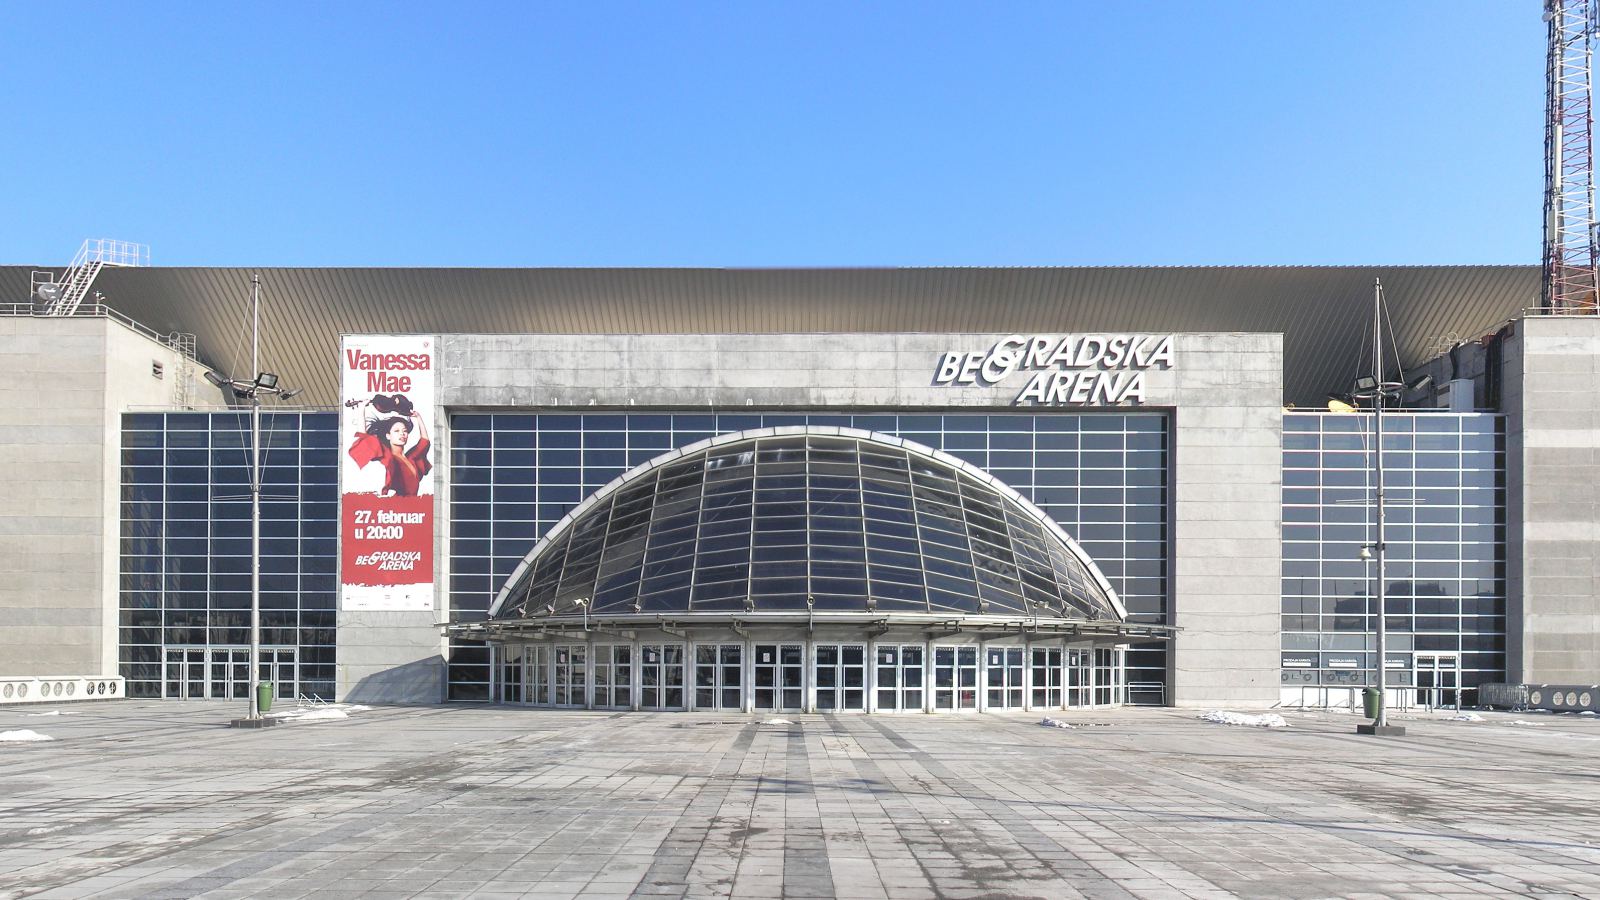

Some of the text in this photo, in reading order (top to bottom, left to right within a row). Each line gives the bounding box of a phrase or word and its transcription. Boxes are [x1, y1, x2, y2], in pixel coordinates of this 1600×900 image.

[346, 349, 430, 371] Vanessa
[935, 335, 1175, 383] BEOGRADSKA
[367, 371, 411, 392] Mae
[1015, 372, 1146, 403] ARENA
[354, 510, 425, 524] 27. februar
[354, 525, 403, 539] u 20:00
[354, 551, 421, 566] BEOGRADSKA
[377, 561, 414, 571] ARENA
